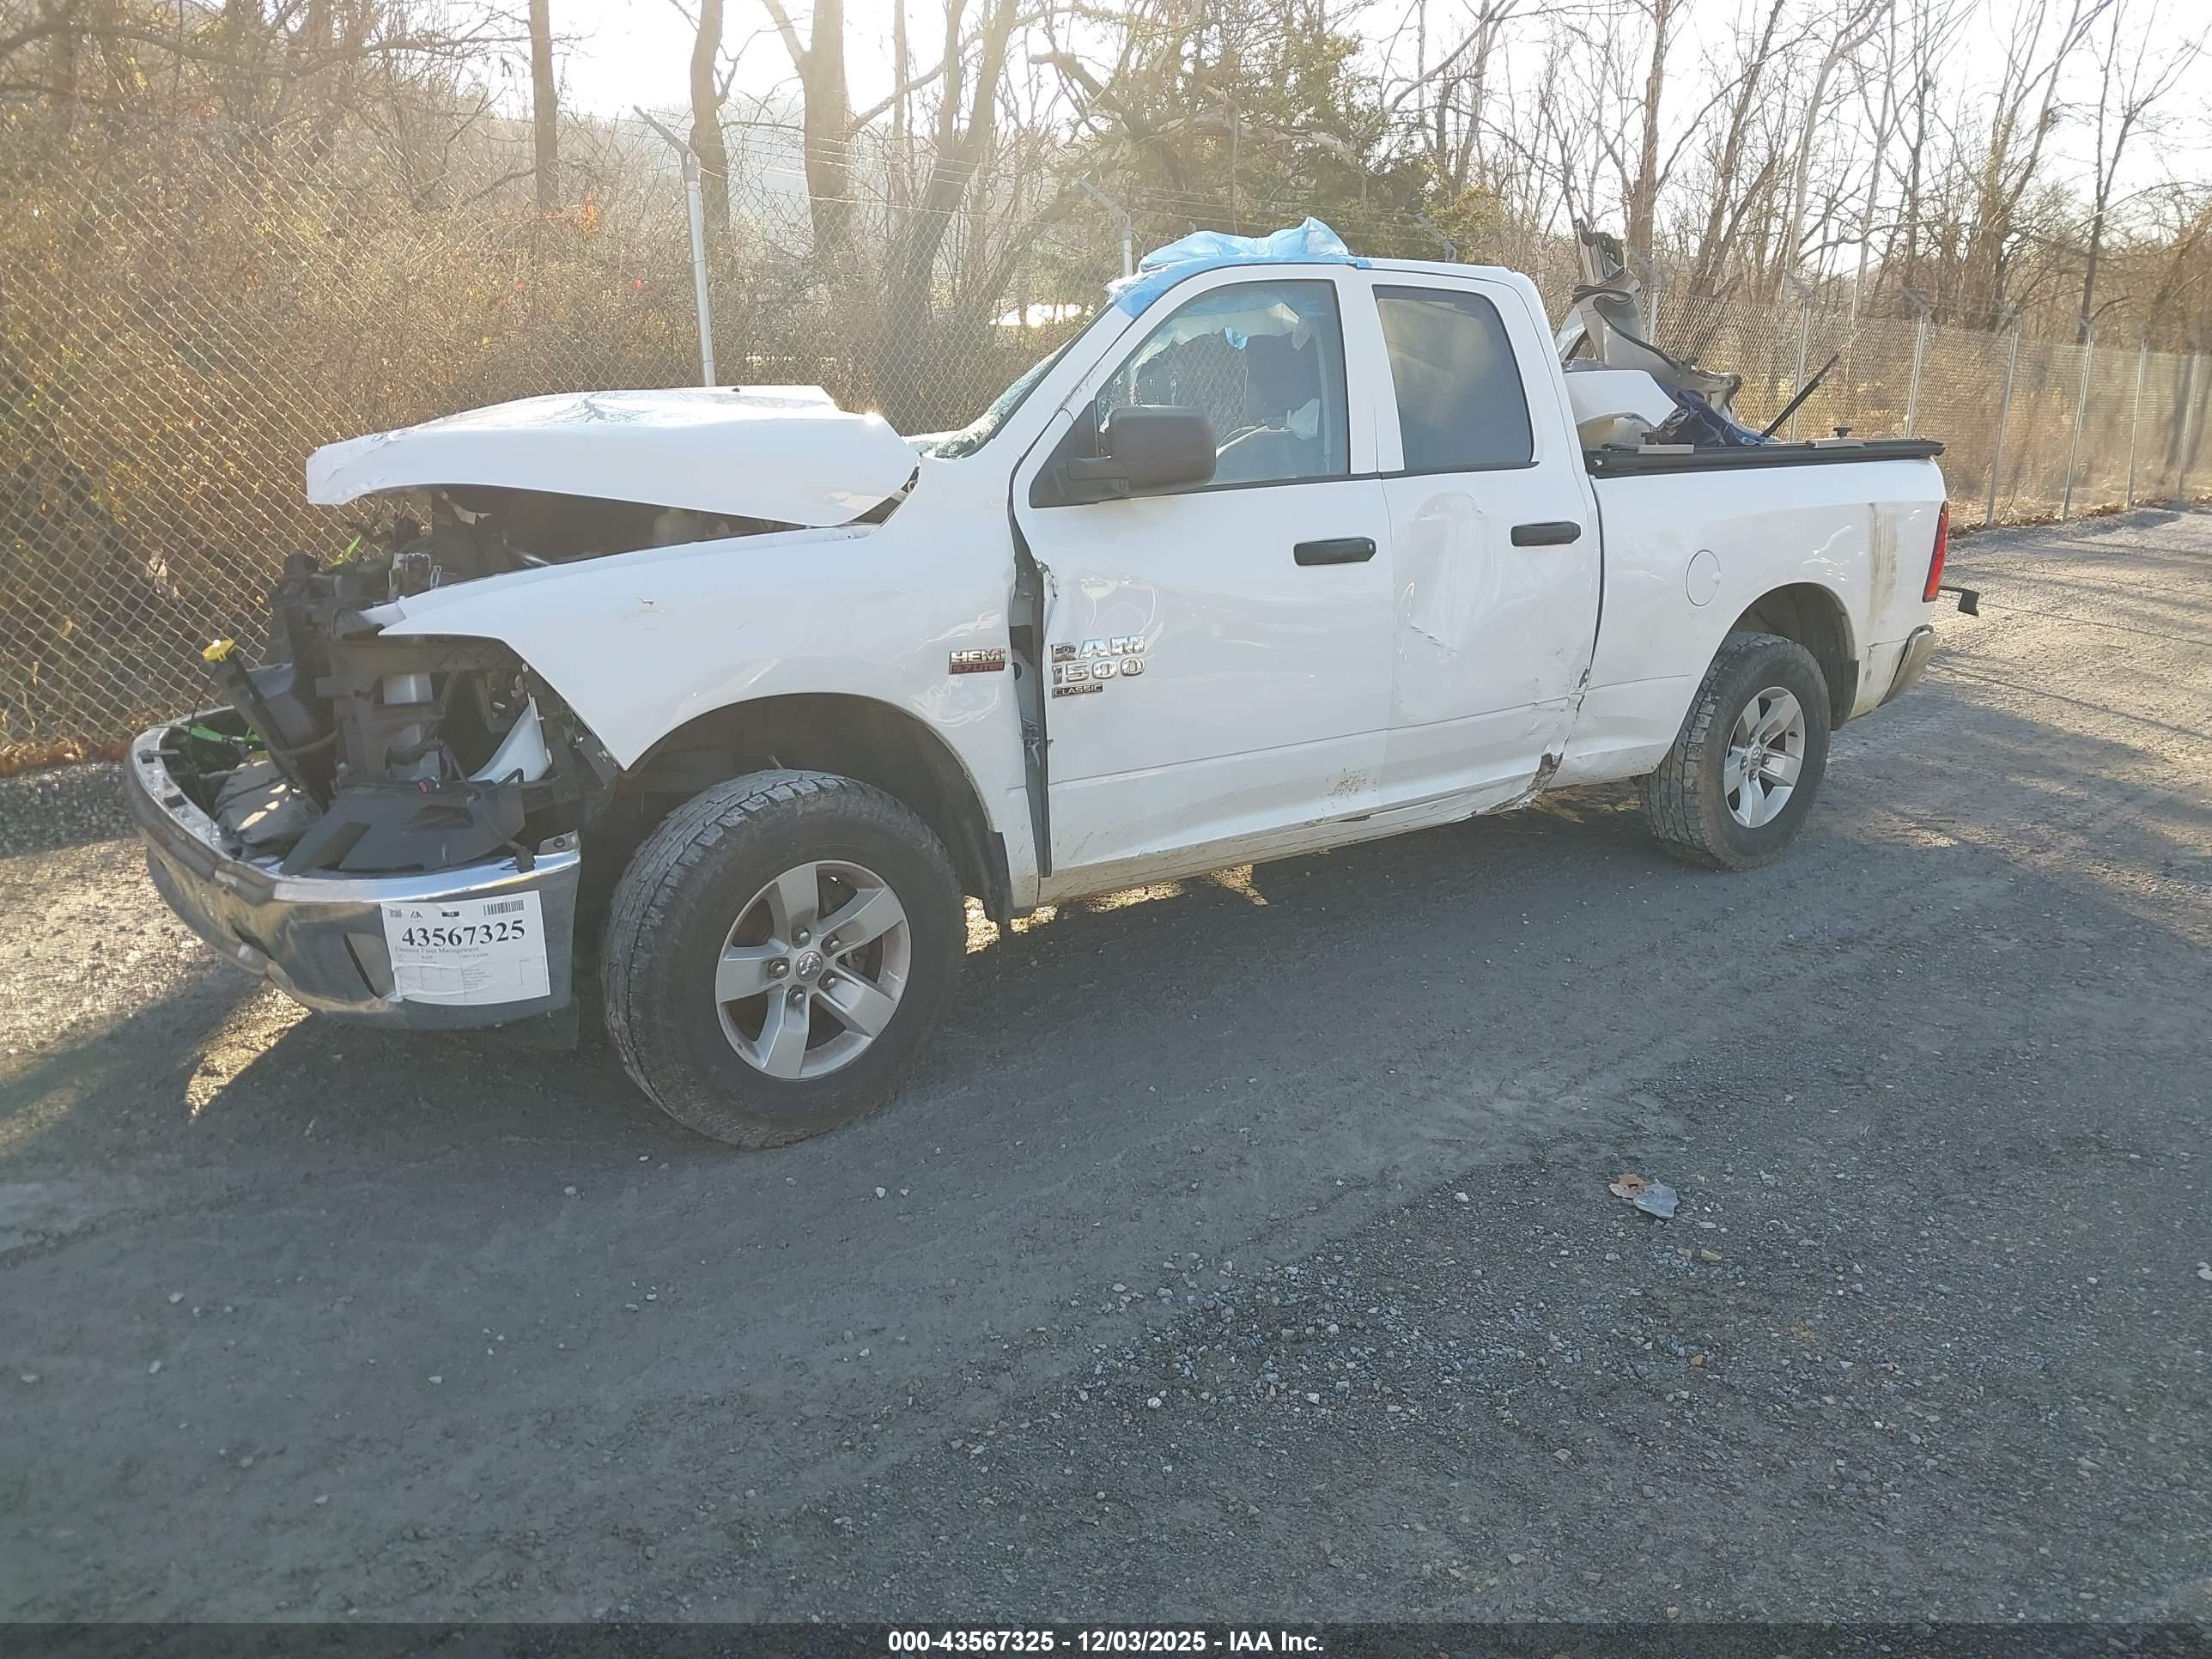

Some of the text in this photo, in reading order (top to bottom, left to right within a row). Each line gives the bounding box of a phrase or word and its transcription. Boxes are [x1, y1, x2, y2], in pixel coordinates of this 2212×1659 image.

[949, 648, 1006, 663] HEMI
[1051, 635, 1146, 663] RAM
[1051, 657, 1146, 684] 1500
[1054, 684, 1103, 696] CLASSIC
[402, 920, 526, 947] 43567325
[438, 946, 479, 955] Management
